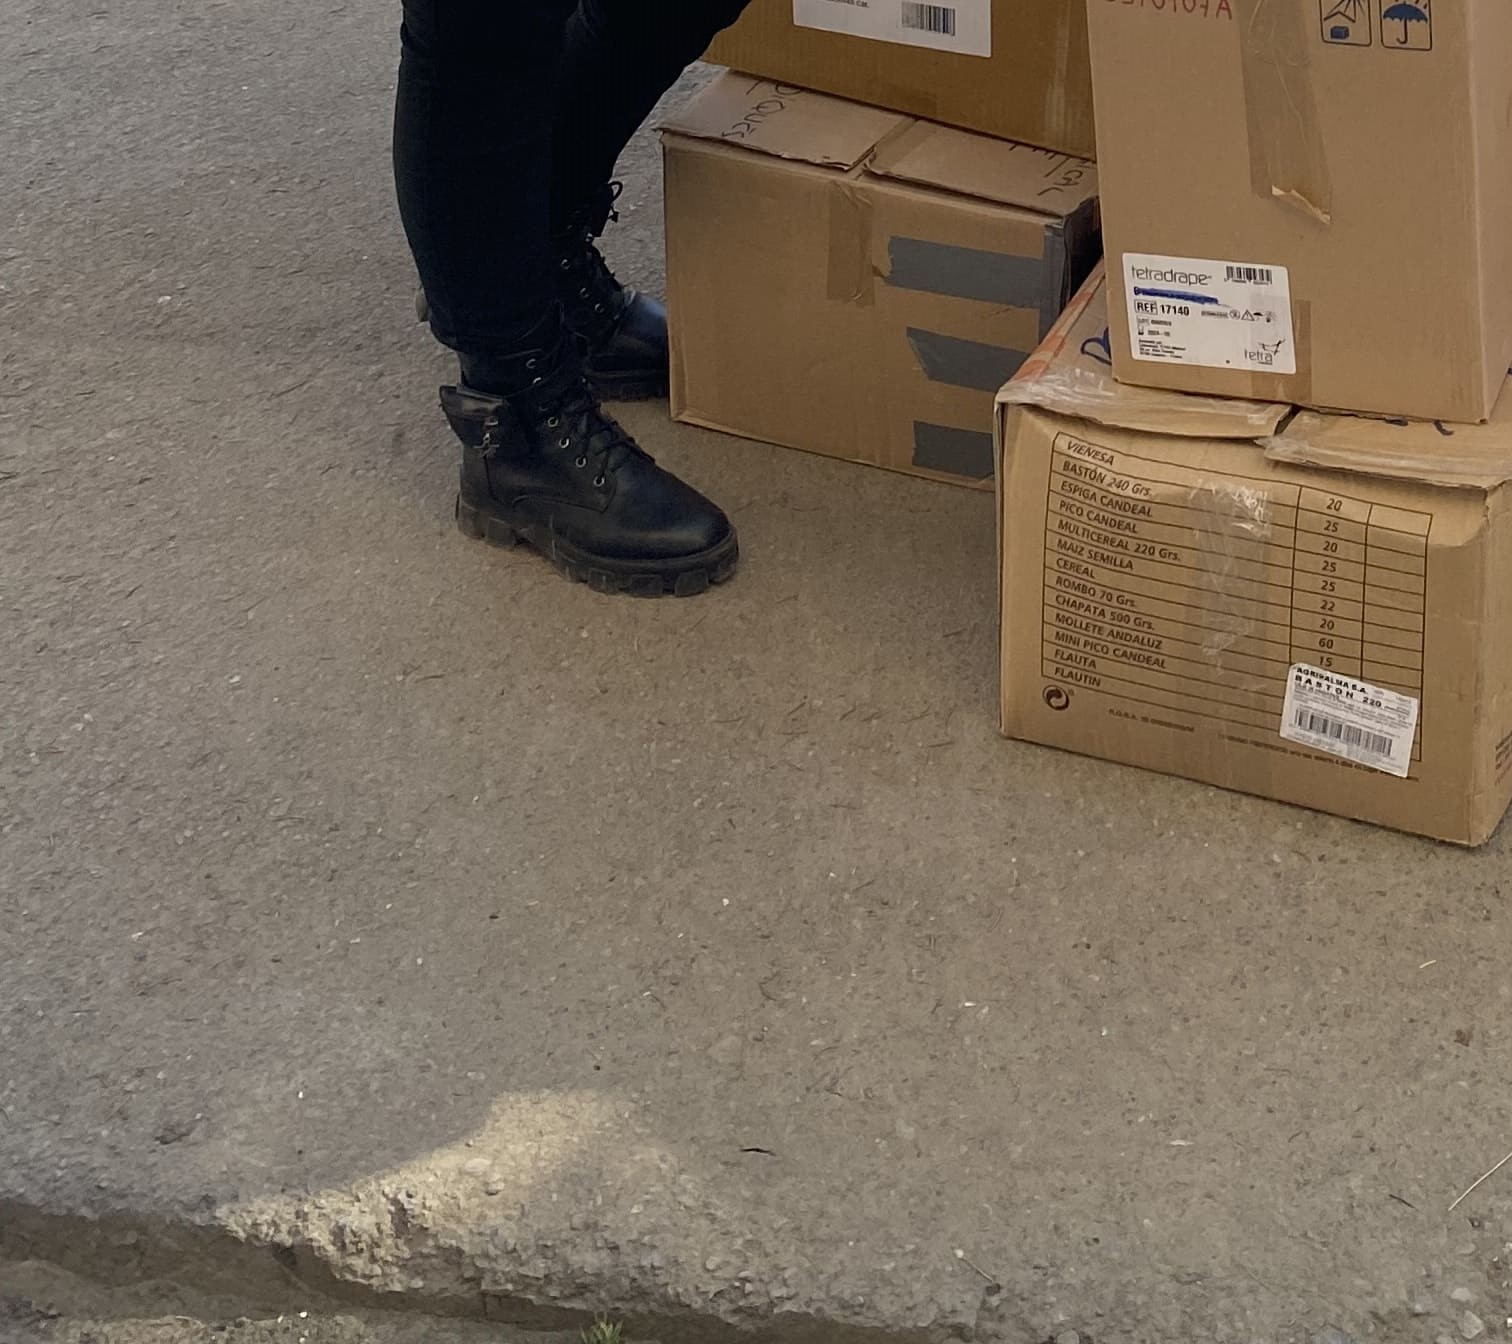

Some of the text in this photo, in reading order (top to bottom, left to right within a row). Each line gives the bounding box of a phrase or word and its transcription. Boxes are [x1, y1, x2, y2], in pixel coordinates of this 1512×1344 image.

[1131, 266, 1209, 286] tetradrape
[1137, 302, 1157, 313] REF
[1160, 304, 1190, 317] 17140
[1244, 347, 1273, 362] tetra
[1066, 439, 1115, 466] VIENESA
[1061, 459, 1153, 497] BASTÓN 240 Grs.
[1060, 480, 1153, 518] ESPIGA CANDEAL
[1326, 497, 1343, 512] 20
[1058, 499, 1138, 534] PICO CANDEAL
[1323, 519, 1339, 533] 25
[1057, 519, 1182, 562] MULTICEREAL 220 Grs.
[1322, 540, 1339, 554] 20
[1056, 538, 1134, 571] MAIZ SEMILLA
[1055, 556, 1096, 580] CEREAL
[1321, 559, 1338, 573] 25
[1055, 575, 1097, 598] ROMBO
[1099, 588, 1114, 603] 70
[1320, 579, 1337, 593] 25
[1054, 593, 1156, 631] CHAPATA 500 Grs.
[1320, 598, 1336, 612] 22
[1054, 612, 1163, 650] MOLLETE ANDALUZ
[1319, 617, 1335, 631] 20
[1054, 630, 1167, 669] MINI PICO CANDEAL
[1318, 637, 1334, 650] 60
[1054, 648, 1097, 670] FLAUTA
[1318, 655, 1333, 668] 15
